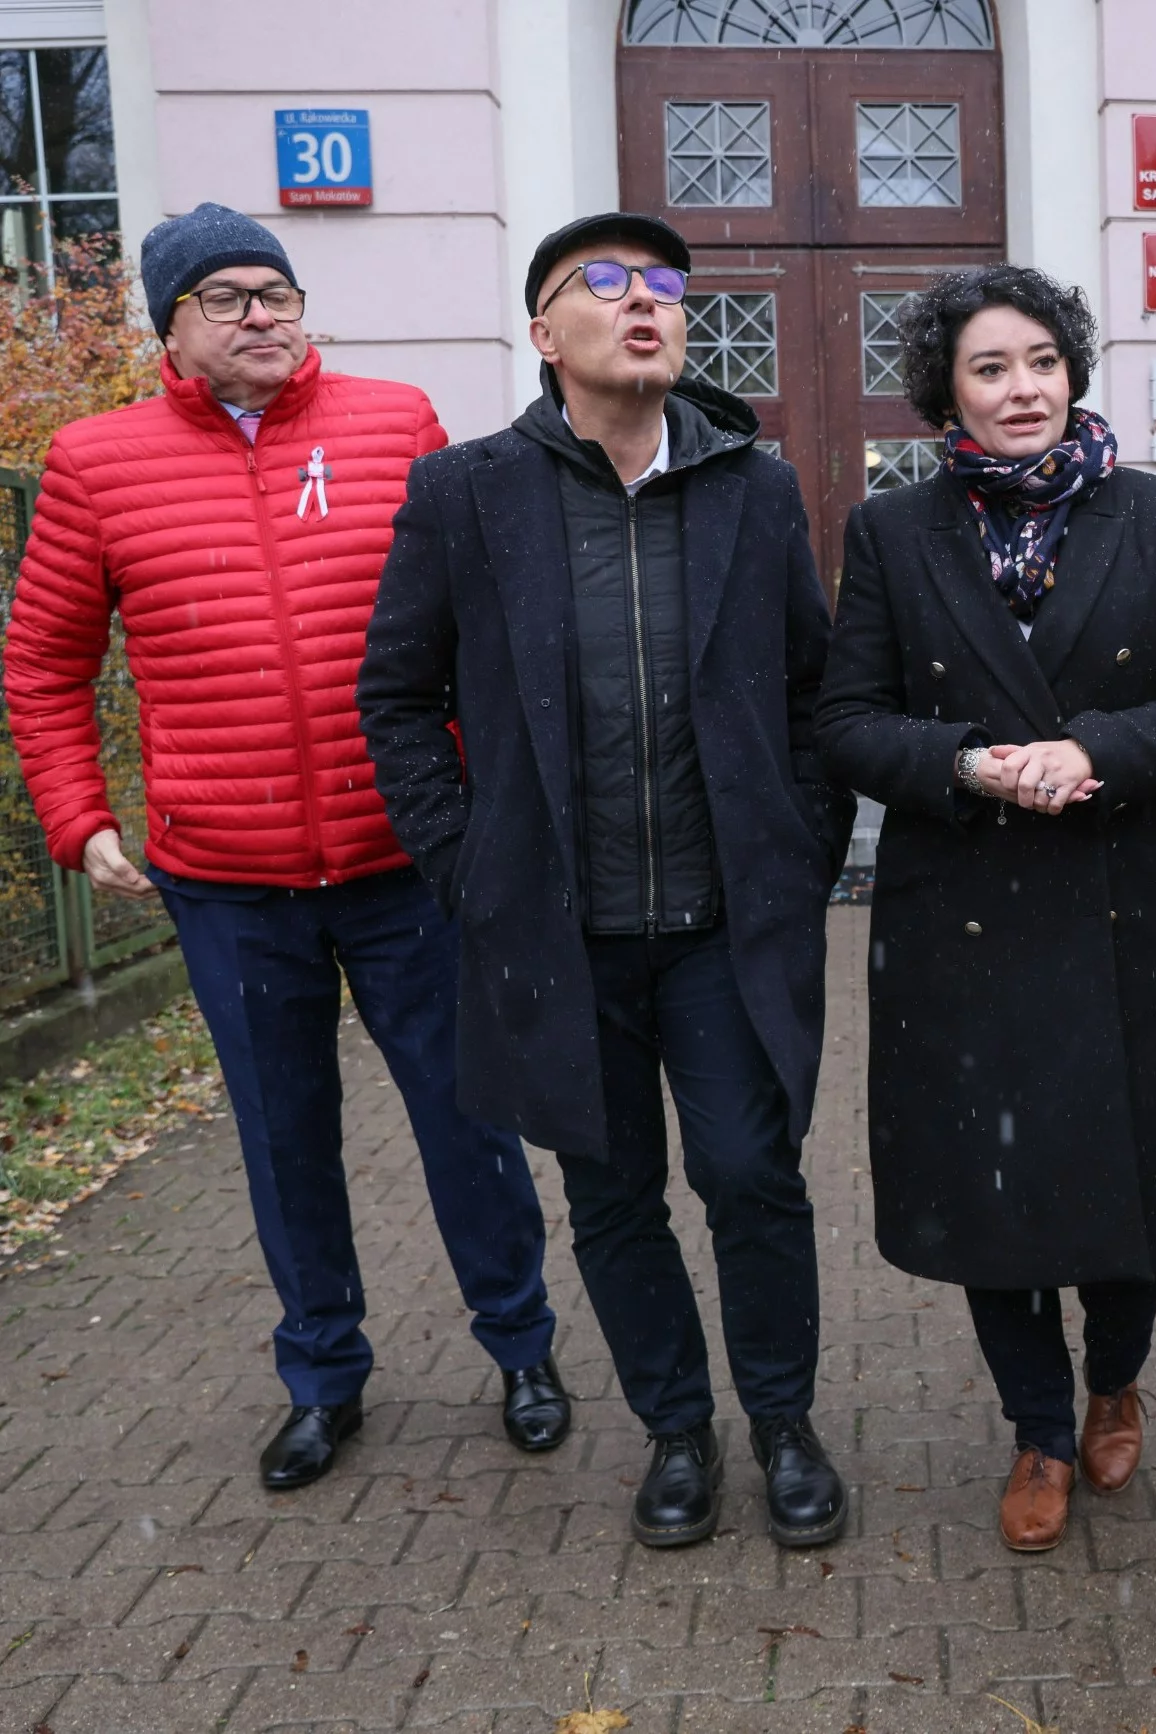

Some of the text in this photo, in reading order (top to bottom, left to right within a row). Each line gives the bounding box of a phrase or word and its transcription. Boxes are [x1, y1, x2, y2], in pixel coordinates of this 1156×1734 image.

[292, 131, 353, 184] 30
[289, 190, 361, 204] Stary Mokotów
